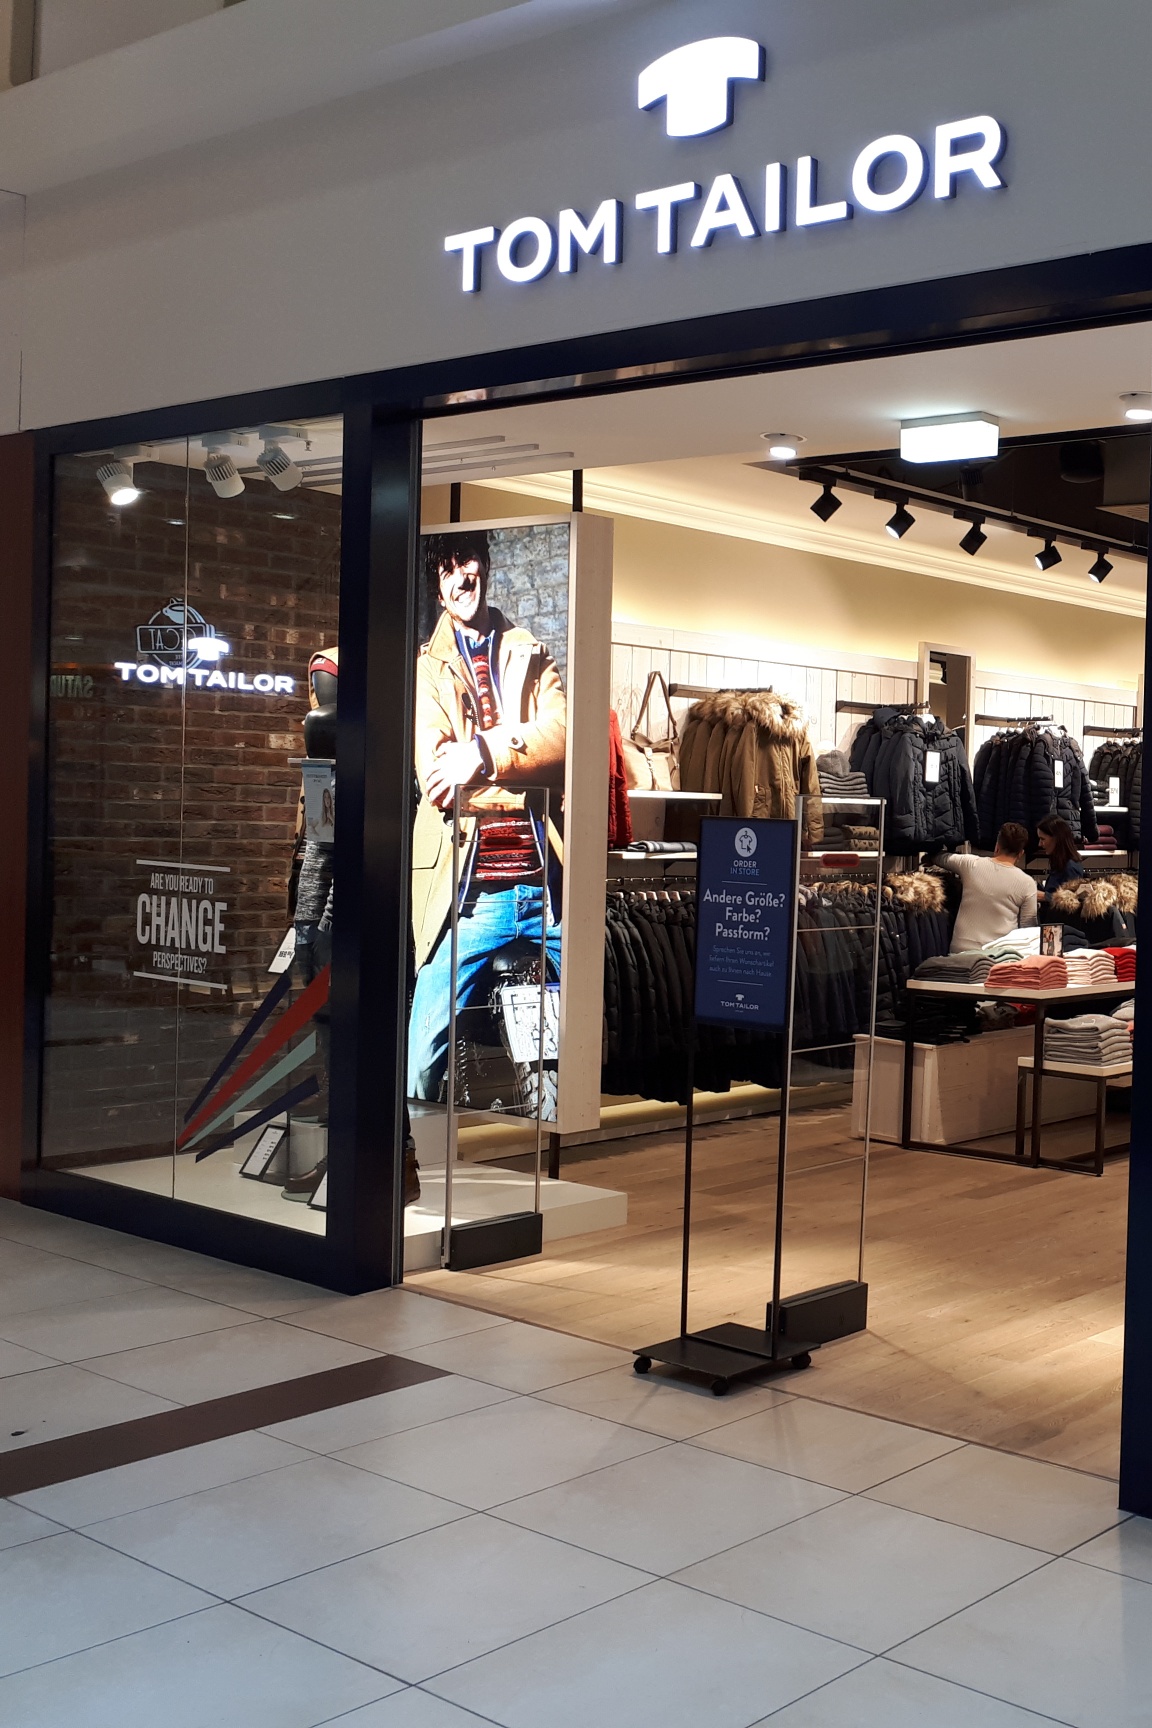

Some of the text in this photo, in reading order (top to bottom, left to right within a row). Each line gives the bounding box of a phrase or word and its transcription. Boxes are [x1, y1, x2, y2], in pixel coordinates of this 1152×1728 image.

[444, 115, 1007, 293] TOM TAILOR
[114, 662, 295, 694] TOM TAILOR
[730, 867, 760, 876] IN STORE
[733, 860, 757, 868] ORDER
[150, 872, 214, 895] ARE YOU READY TO
[703, 888, 786, 908] Andere Größe?
[136, 893, 228, 954] CHANGE
[725, 907, 762, 923] Farbe?
[715, 923, 771, 941] Passform?
[152, 951, 207, 974] PERSPECTIVES?
[735, 1002, 760, 1010] TAILOR
